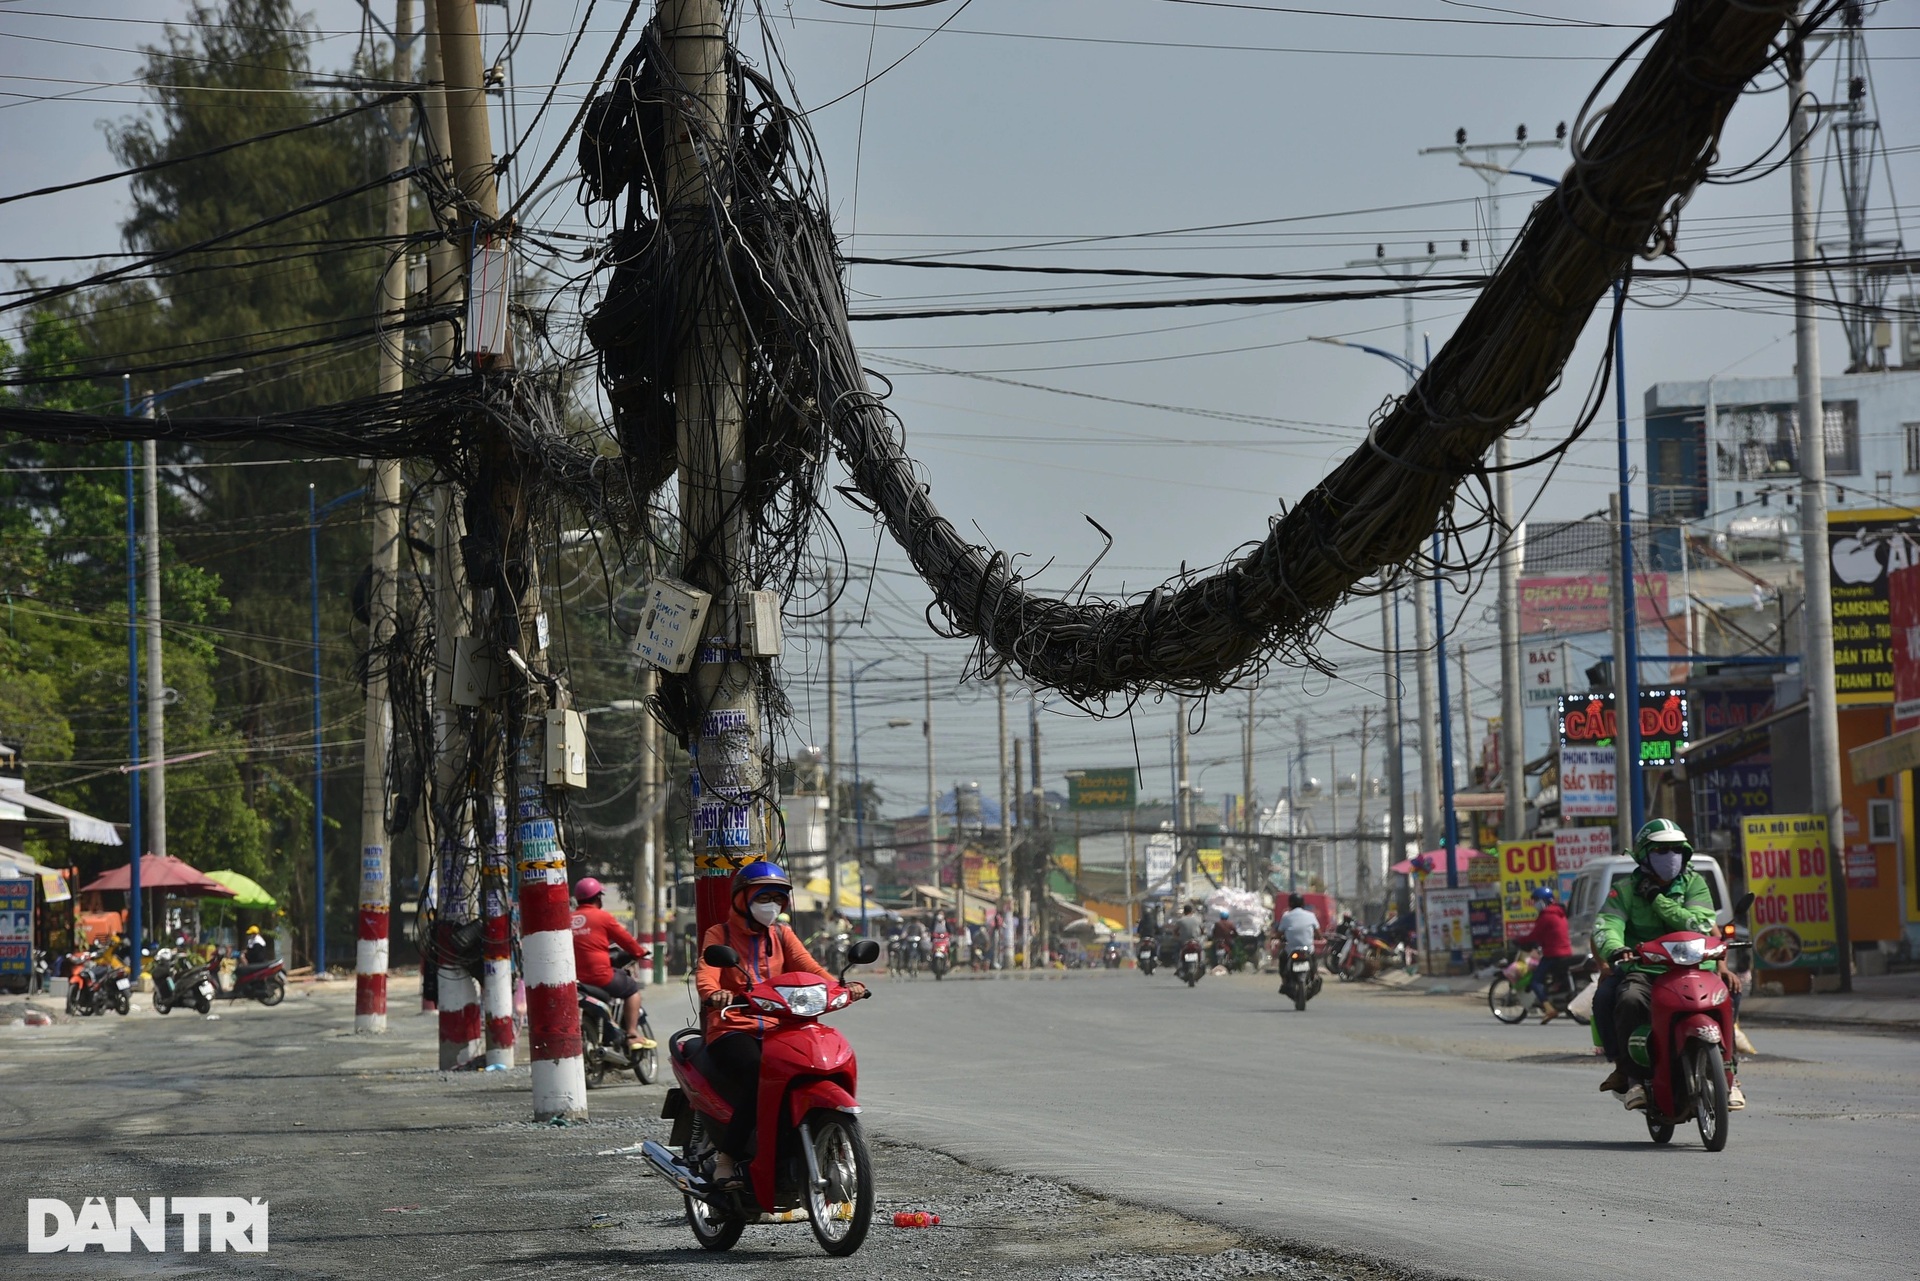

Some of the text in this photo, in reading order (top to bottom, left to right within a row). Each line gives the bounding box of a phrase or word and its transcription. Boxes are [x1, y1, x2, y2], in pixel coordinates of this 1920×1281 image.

[1833, 600, 1889, 617] SAMSUNG
[636, 642, 652, 656] 178
[662, 638, 674, 649] 33
[1836, 673, 1872, 689] THANH
[1748, 823, 1766, 834] GIA
[1556, 834, 1581, 845] MUA
[1750, 839, 1826, 879] BÚN BÒ
[1753, 881, 1830, 925] GỐC HUẾ
